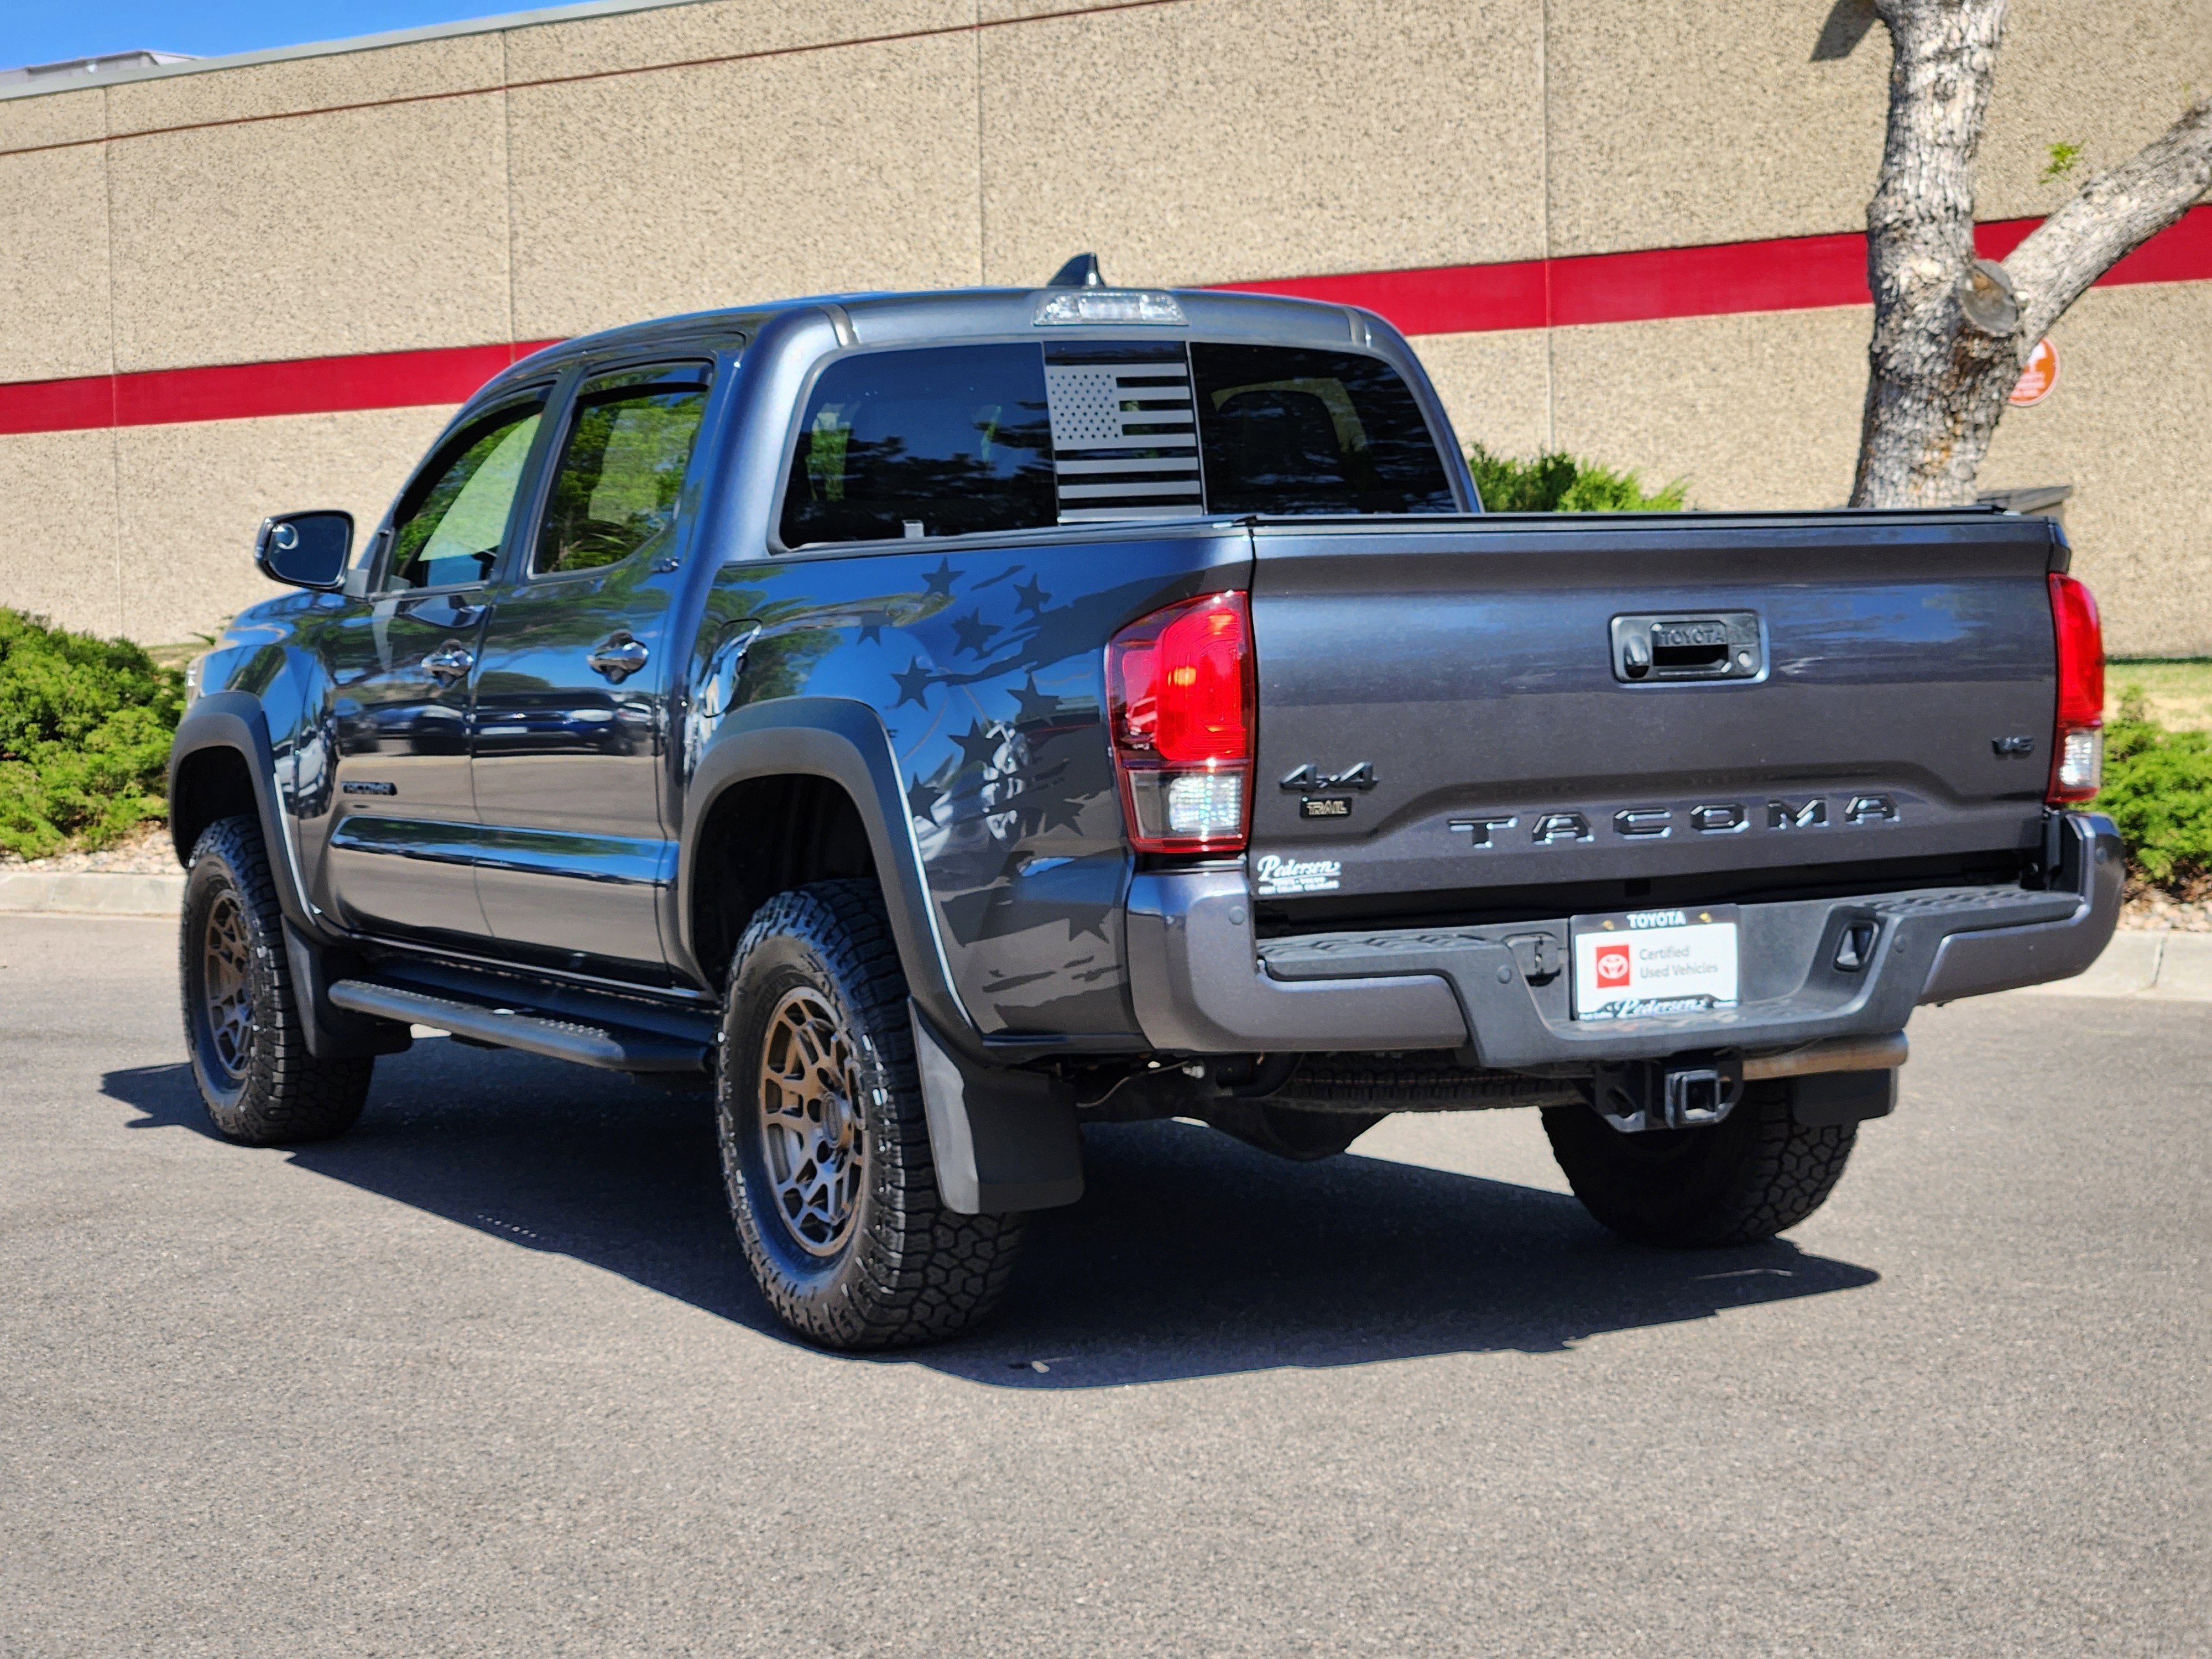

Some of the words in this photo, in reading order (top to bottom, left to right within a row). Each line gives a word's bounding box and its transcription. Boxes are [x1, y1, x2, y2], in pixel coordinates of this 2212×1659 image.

[1660, 628, 1724, 645] TOYOTA
[1991, 735, 2033, 753] V6
[1306, 800, 1348, 816] TRAIL
[1448, 794, 1902, 848] TACOMA
[1626, 910, 1687, 929] TOYOTA
[1639, 945, 1690, 961] Certified
[1640, 966, 1669, 978] Used
[1671, 962, 1719, 975] Vehicles
